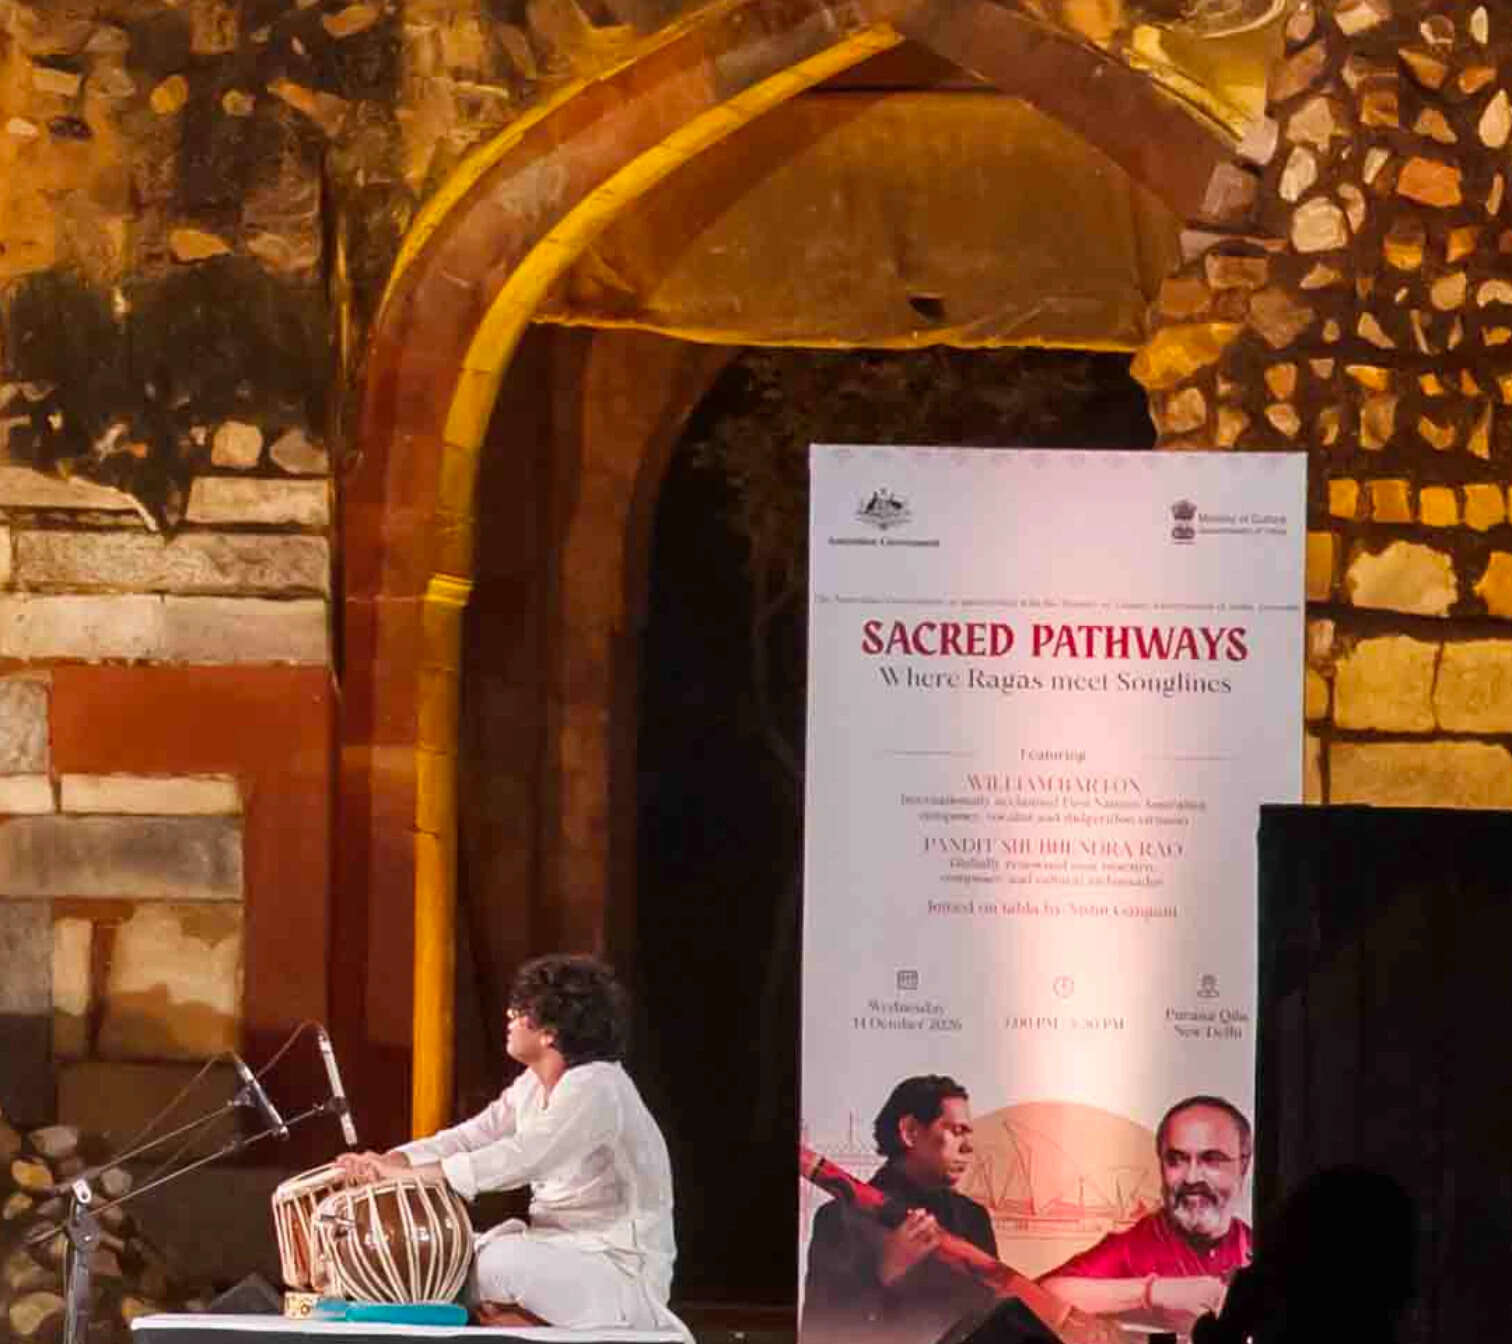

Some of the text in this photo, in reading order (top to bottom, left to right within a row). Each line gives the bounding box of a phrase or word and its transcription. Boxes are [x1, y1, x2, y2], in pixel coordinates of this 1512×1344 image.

[861, 619, 1249, 662] SACRED PATHWAYS
[879, 666, 1232, 698] Where Ragas meet Songlines
[1020, 748, 1087, 763] Featuring
[966, 773, 1142, 794] WILLIAM BARTON
